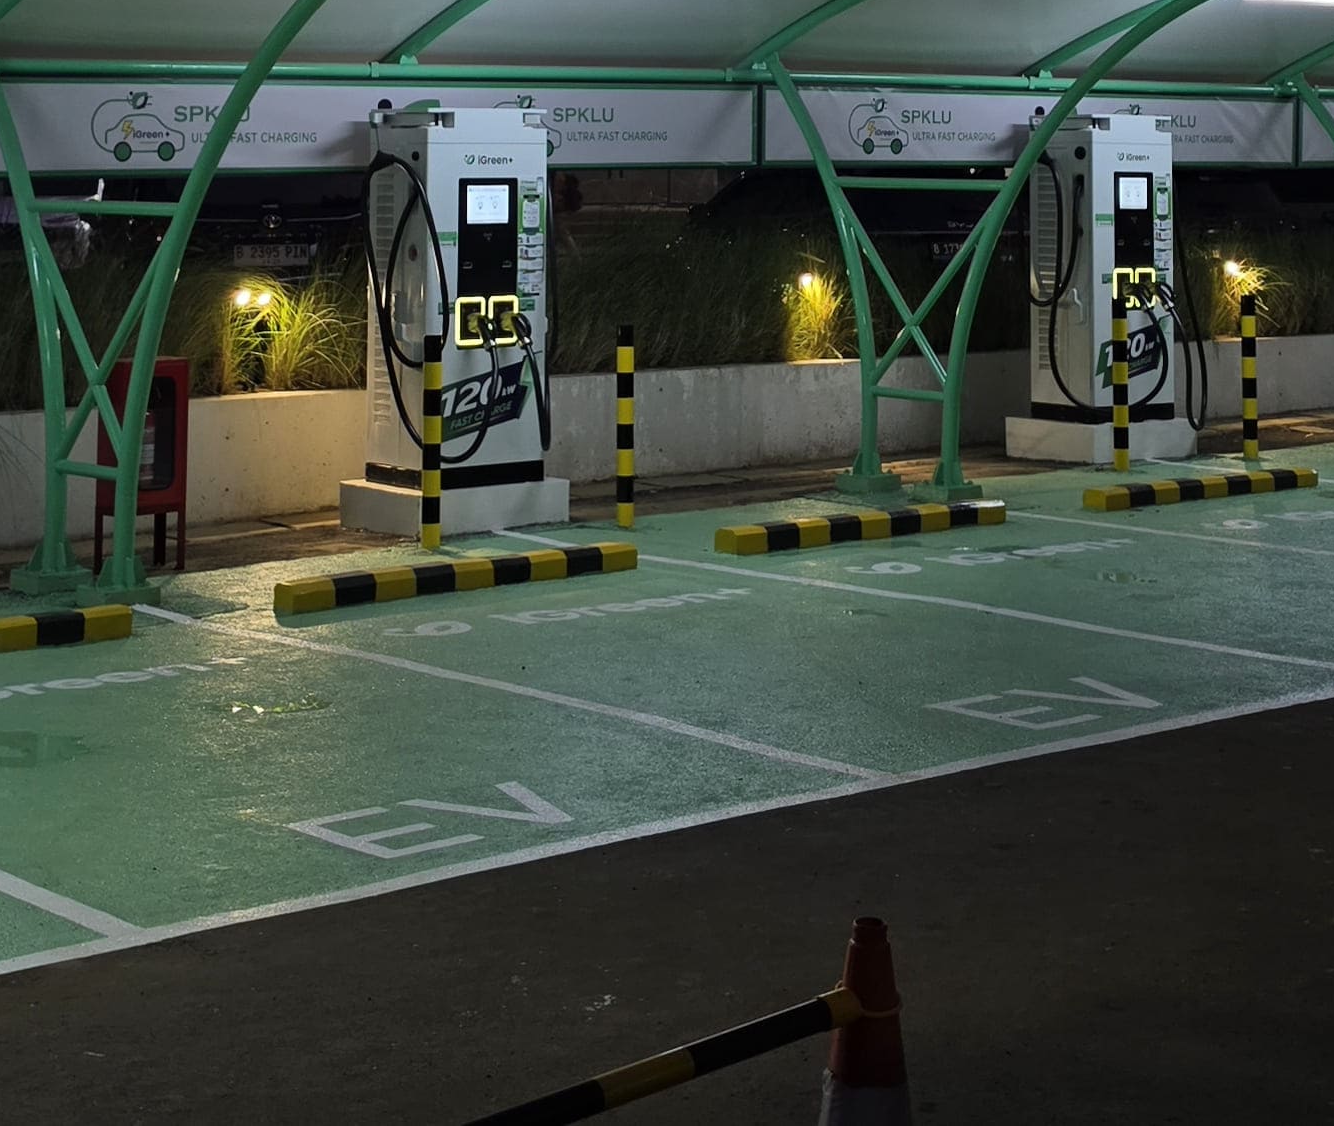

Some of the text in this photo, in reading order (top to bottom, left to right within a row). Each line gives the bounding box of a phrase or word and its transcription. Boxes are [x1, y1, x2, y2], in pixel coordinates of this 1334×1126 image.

[174, 105, 250, 122] SPKU
[553, 107, 614, 123] SPKLU
[901, 110, 952, 124] SPKLU
[261, 132, 317, 143] CHARGING
[567, 131, 668, 142] ULTRA FAST CHARGING
[912, 131, 937, 141] ULTRA
[938, 132, 956, 141] FAST
[236, 246, 244, 258] B
[285, 245, 307, 258] PIN
[1105, 333, 1145, 367] 10
[441, 375, 502, 418] 120
[926, 676, 1163, 731] EV
[286, 781, 573, 859] EV
